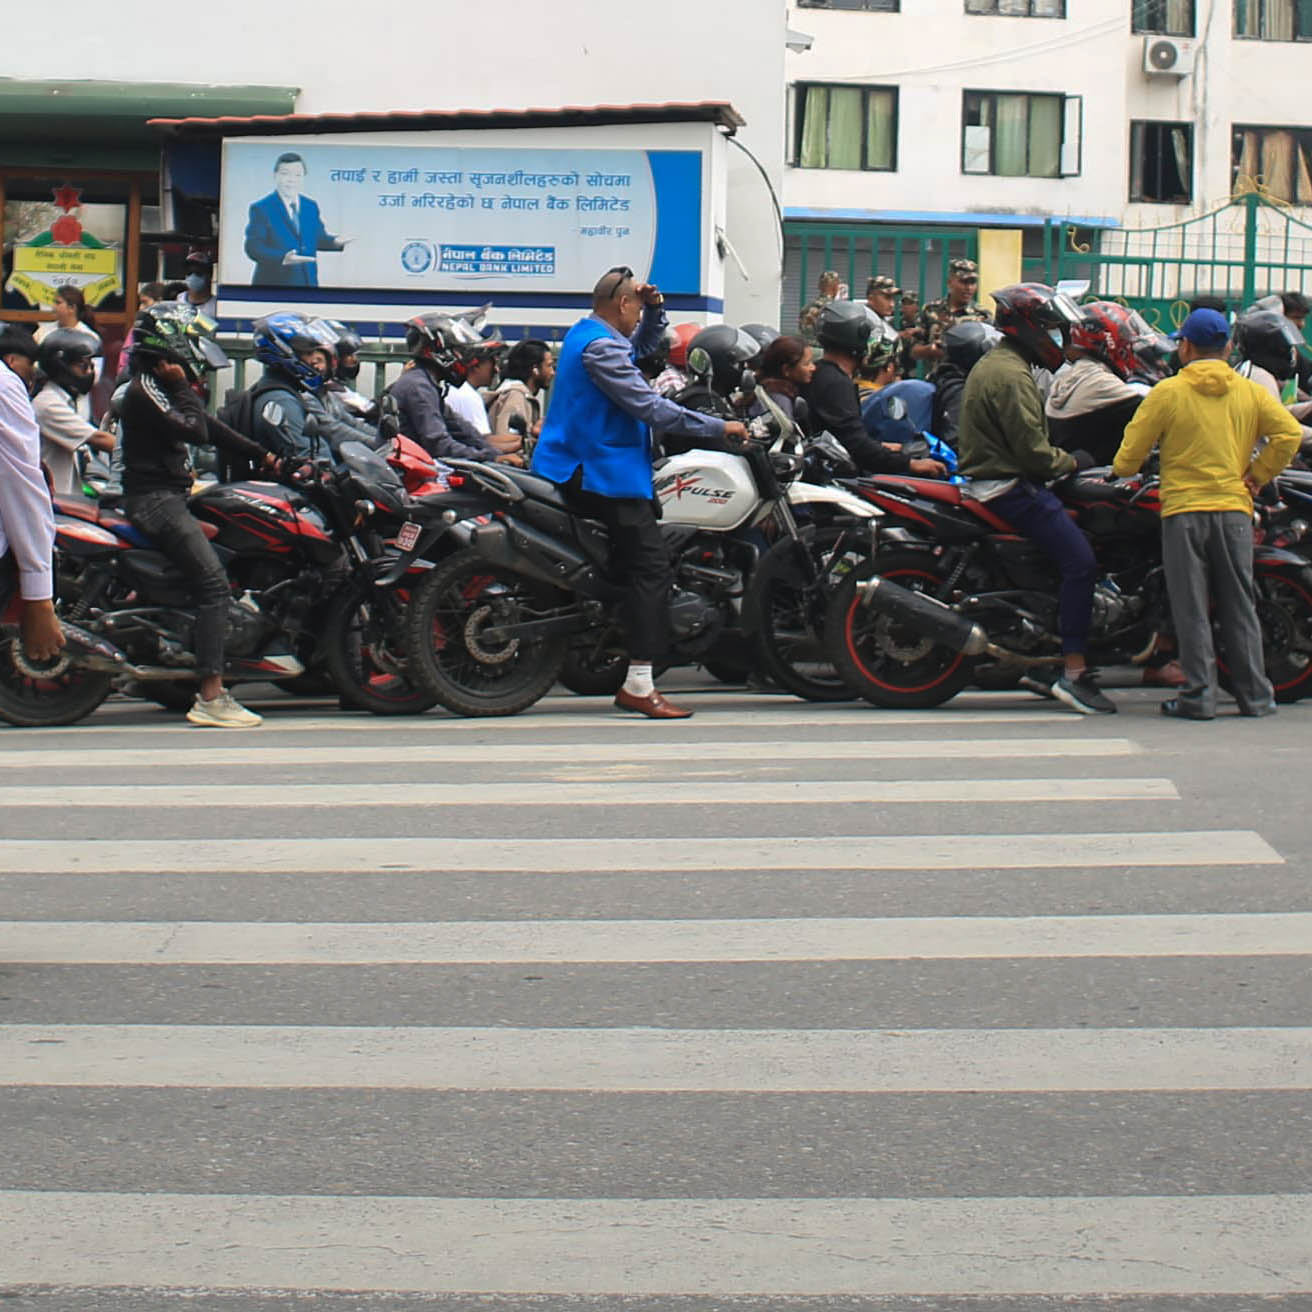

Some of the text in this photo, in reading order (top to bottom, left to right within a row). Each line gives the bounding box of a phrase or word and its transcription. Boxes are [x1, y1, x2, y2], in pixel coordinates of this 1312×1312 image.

[371, 171, 381, 184] र
[387, 168, 419, 185] हामी
[425, 171, 463, 185] जस्ता
[586, 170, 631, 188] सोचमा
[411, 193, 475, 210] भरिरहेको
[481, 197, 494, 209] छ
[500, 195, 540, 210] नेपाल
[576, 195, 631, 212] लिमिटेड
[441, 247, 476, 261] नेपाल
[508, 248, 553, 262] लिमिटेड
[441, 262, 554, 273] NEPAL BANK LIMITED
